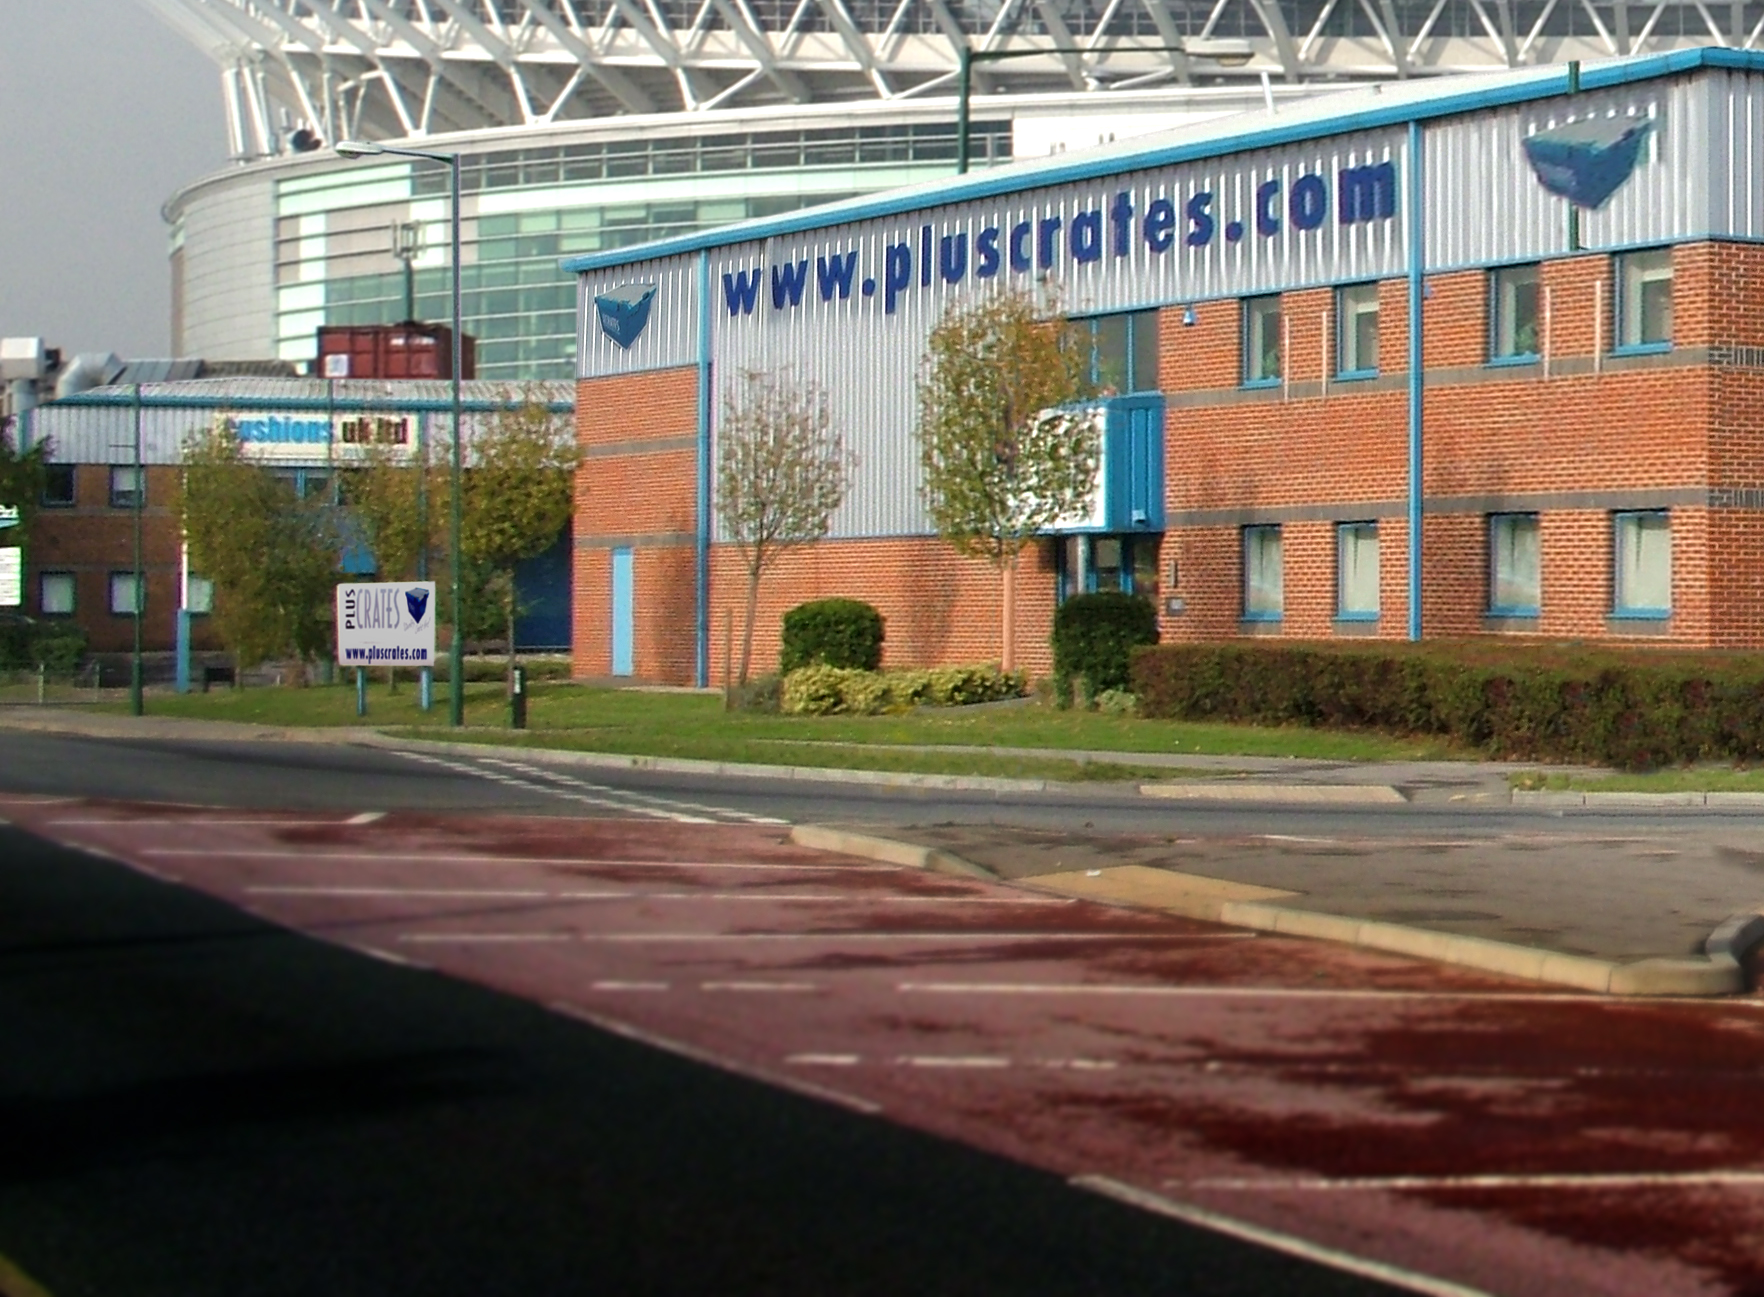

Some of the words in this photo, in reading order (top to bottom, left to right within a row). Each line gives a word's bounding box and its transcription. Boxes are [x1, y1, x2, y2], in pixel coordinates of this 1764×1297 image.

[723, 161, 1396, 317] www.pluscrates.com
[345, 589, 356, 629] PLUS
[357, 588, 401, 630] CRATES
[345, 645, 428, 664] www.pluscrates.com
